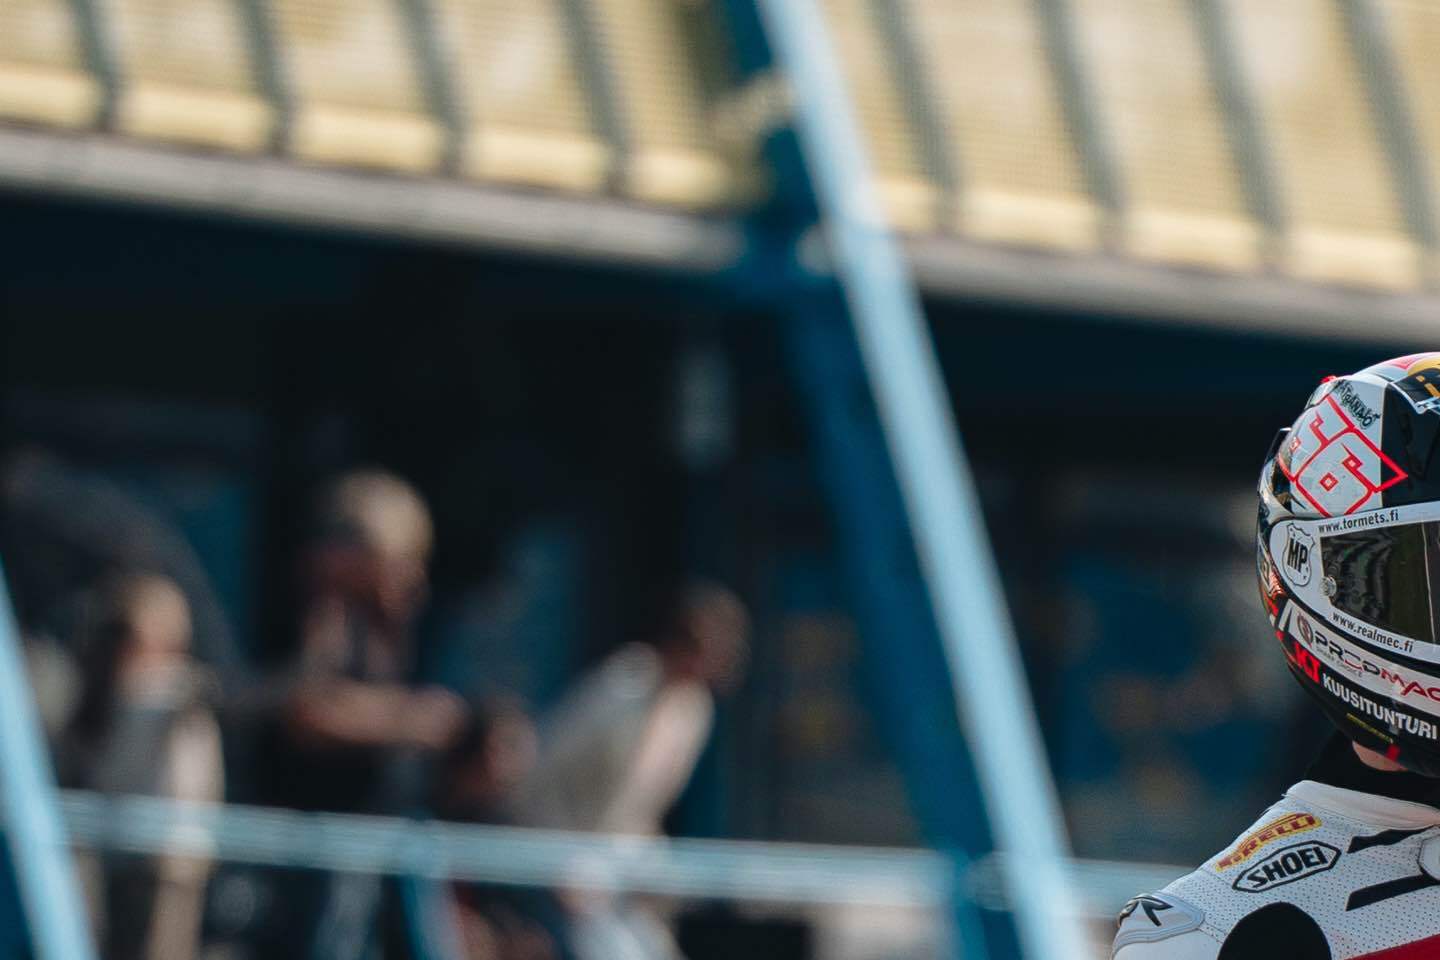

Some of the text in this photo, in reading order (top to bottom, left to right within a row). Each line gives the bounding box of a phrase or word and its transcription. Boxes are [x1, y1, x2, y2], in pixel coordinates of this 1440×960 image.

[1318, 510, 1399, 533] www.tormets.fi
[1332, 612, 1413, 653] www.realmec.fi
[1322, 673, 1438, 740] KUUSITUNTURI
[1247, 846, 1329, 888] SHOEI
